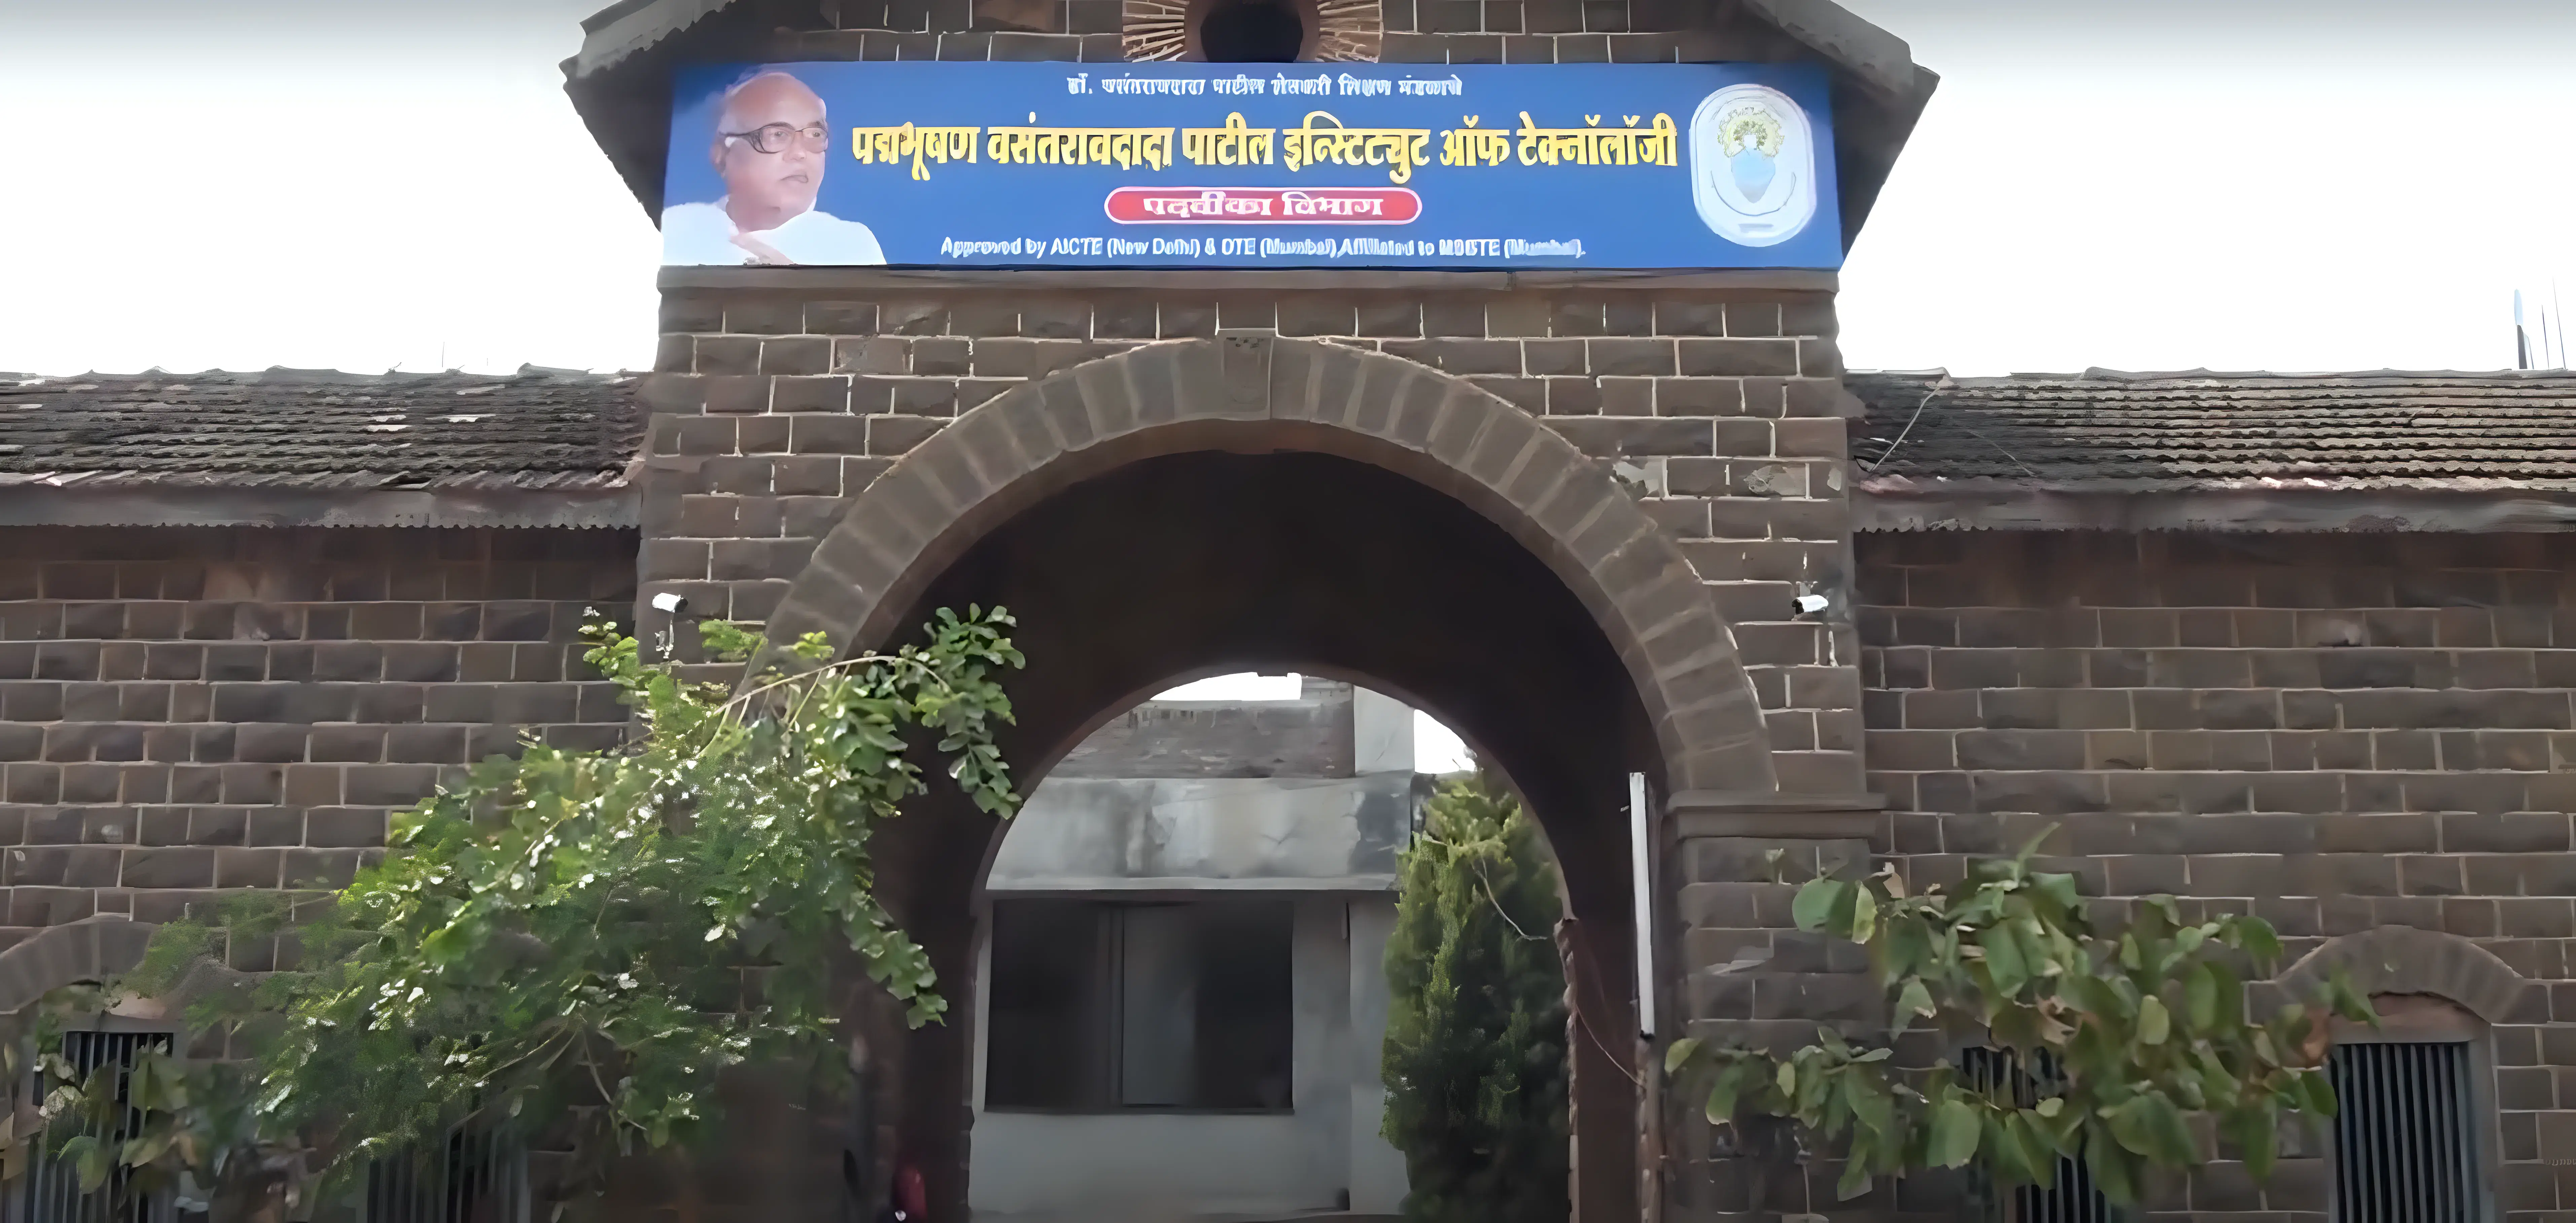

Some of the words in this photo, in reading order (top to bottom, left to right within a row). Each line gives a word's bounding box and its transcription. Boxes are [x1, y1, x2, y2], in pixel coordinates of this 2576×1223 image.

[852, 121, 980, 180] पद्मभूषण
[987, 112, 1175, 171] वसंतरावदादा
[1182, 111, 1276, 165] पाटील
[1440, 115, 1510, 166] ऑफ
[1516, 111, 1678, 166] टेक्नॉलॉजी
[1282, 191, 1384, 215] विभाग
[941, 236, 1021, 258] Approved
[1025, 238, 1046, 259] by
[1050, 237, 1103, 255] AICTE
[1107, 238, 1149, 258] (New
[1205, 238, 1216, 256] &
[1418, 240, 1434, 256] to
